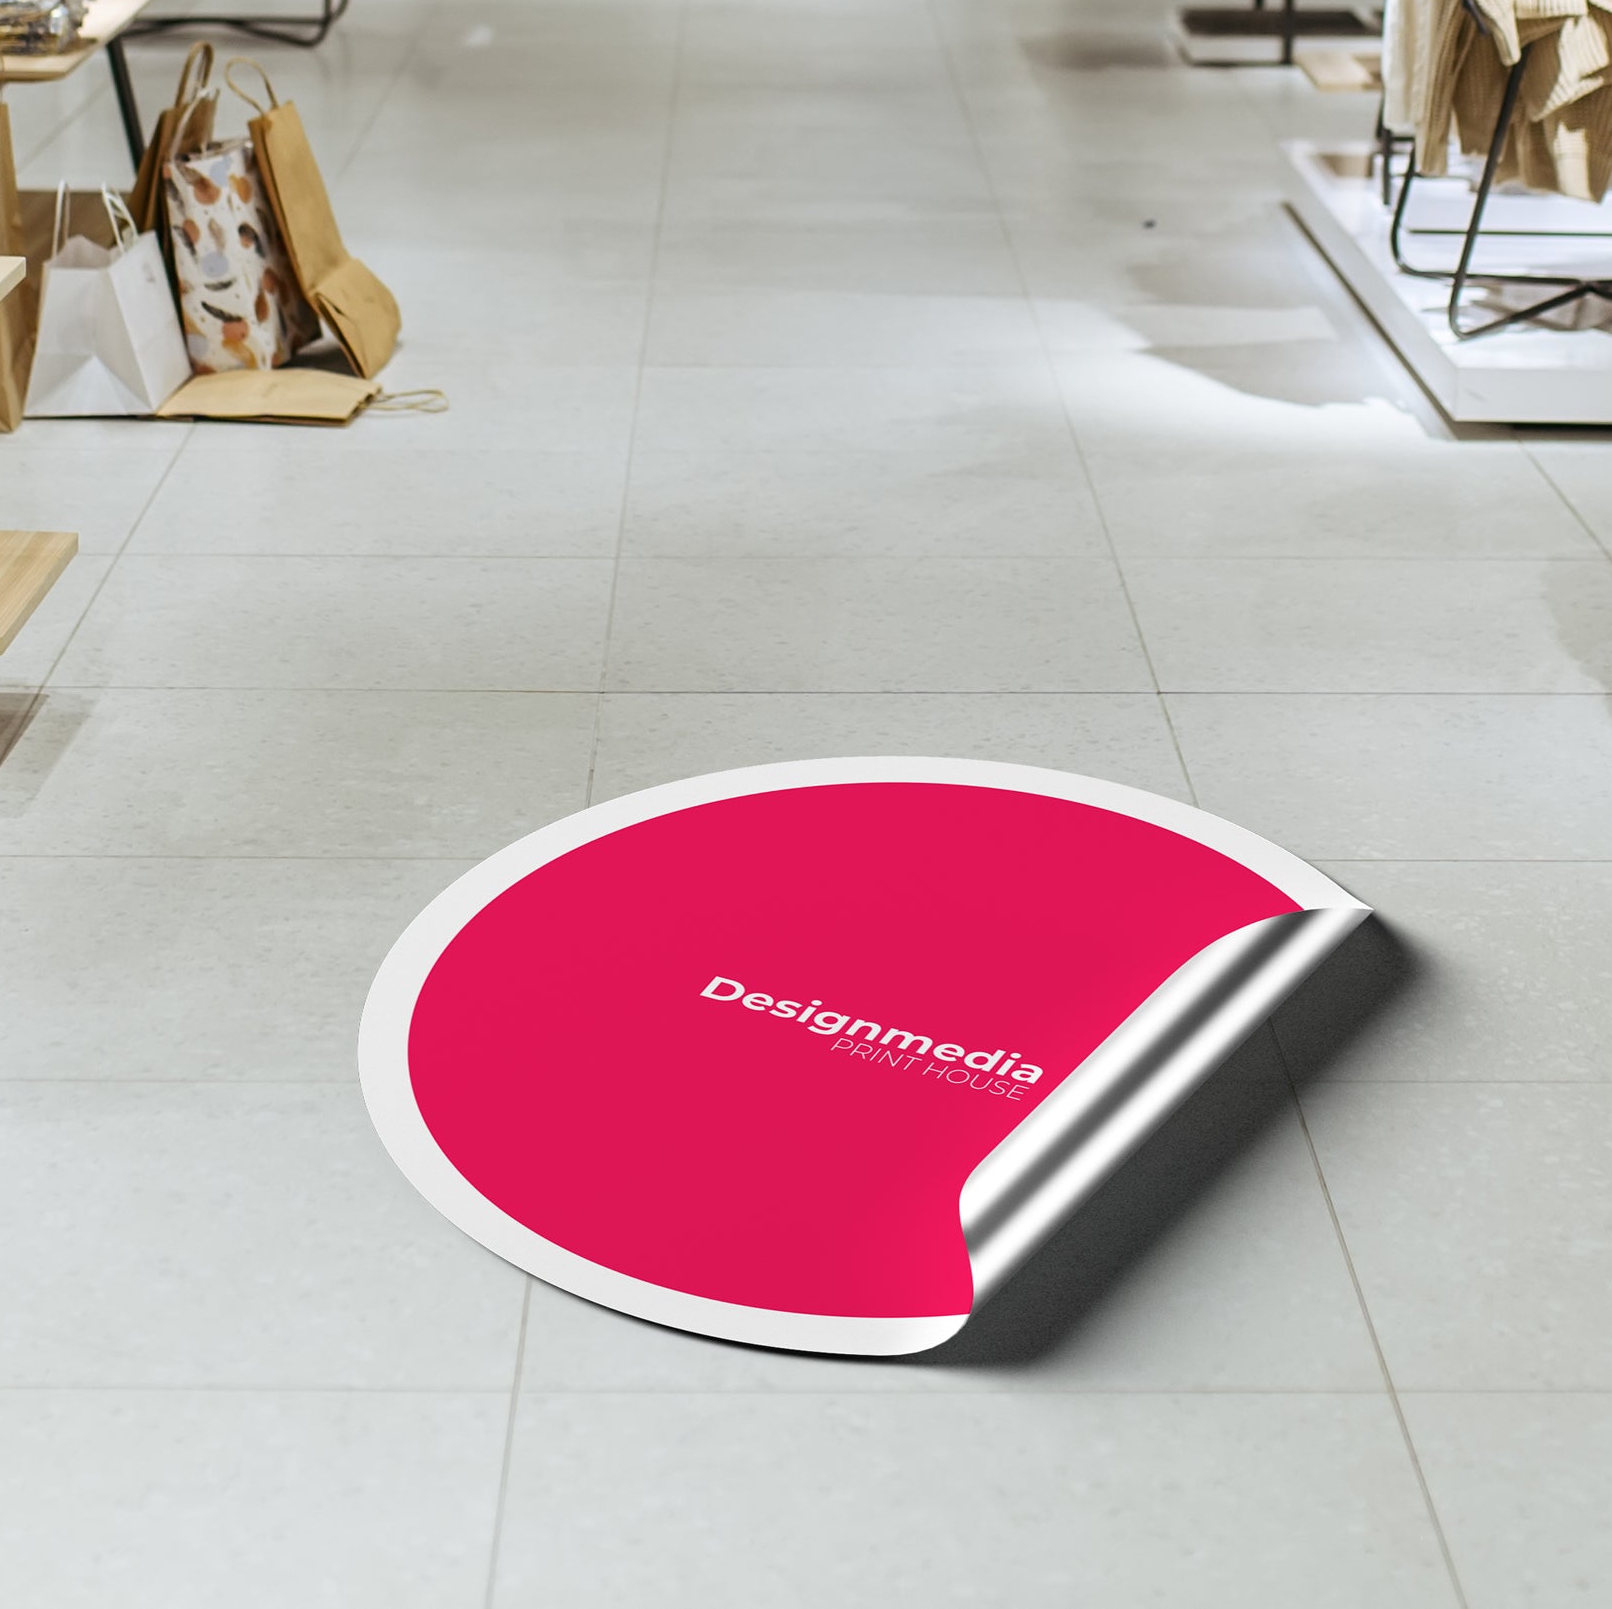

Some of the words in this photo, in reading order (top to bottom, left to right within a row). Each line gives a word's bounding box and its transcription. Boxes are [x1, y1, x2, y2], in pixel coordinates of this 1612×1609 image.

[700, 976, 1044, 1083] Designmedia
[831, 1038, 922, 1070] PRINT
[923, 1062, 1031, 1101] HOUSE
